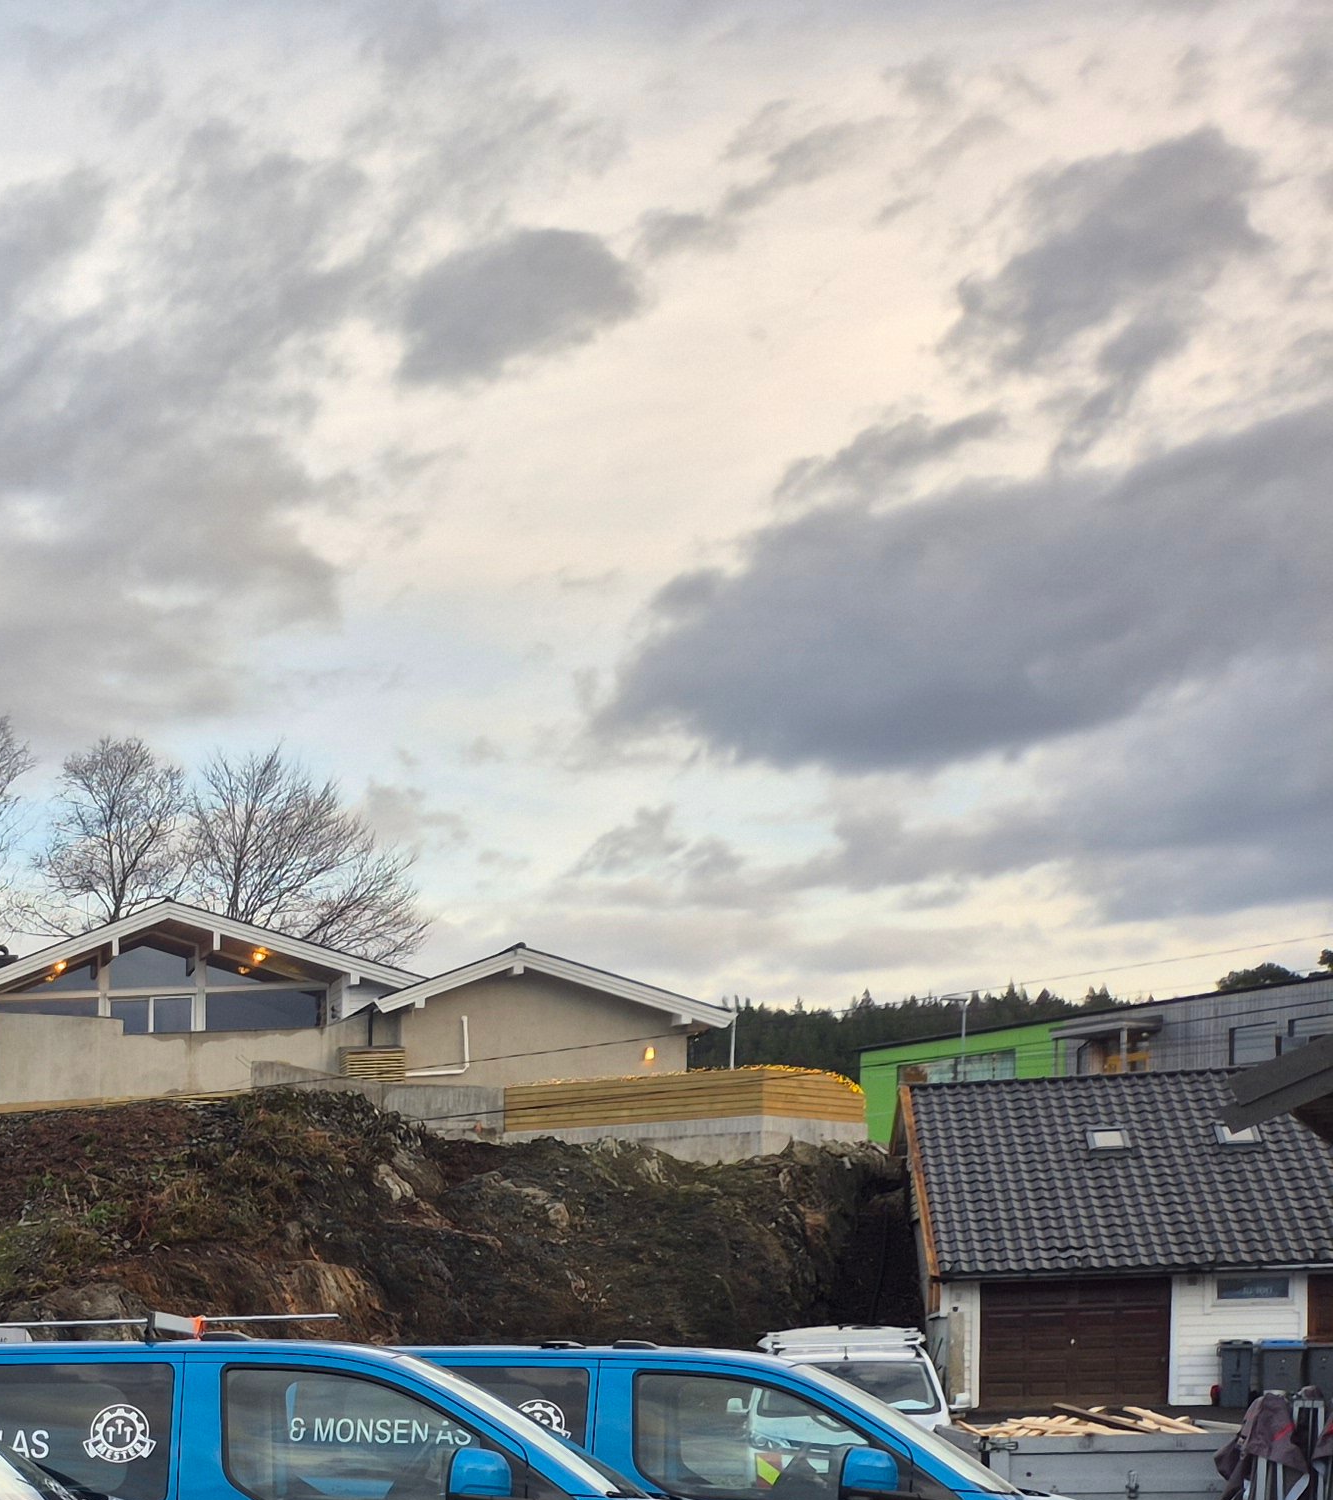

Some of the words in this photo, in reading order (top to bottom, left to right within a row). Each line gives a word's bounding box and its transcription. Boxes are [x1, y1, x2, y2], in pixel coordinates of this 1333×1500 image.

[11, 1429, 50, 1459] AS
[289, 1417, 306, 1442] &
[313, 1417, 429, 1444] MONSEN
[95, 1442, 145, 1460] MESTER
